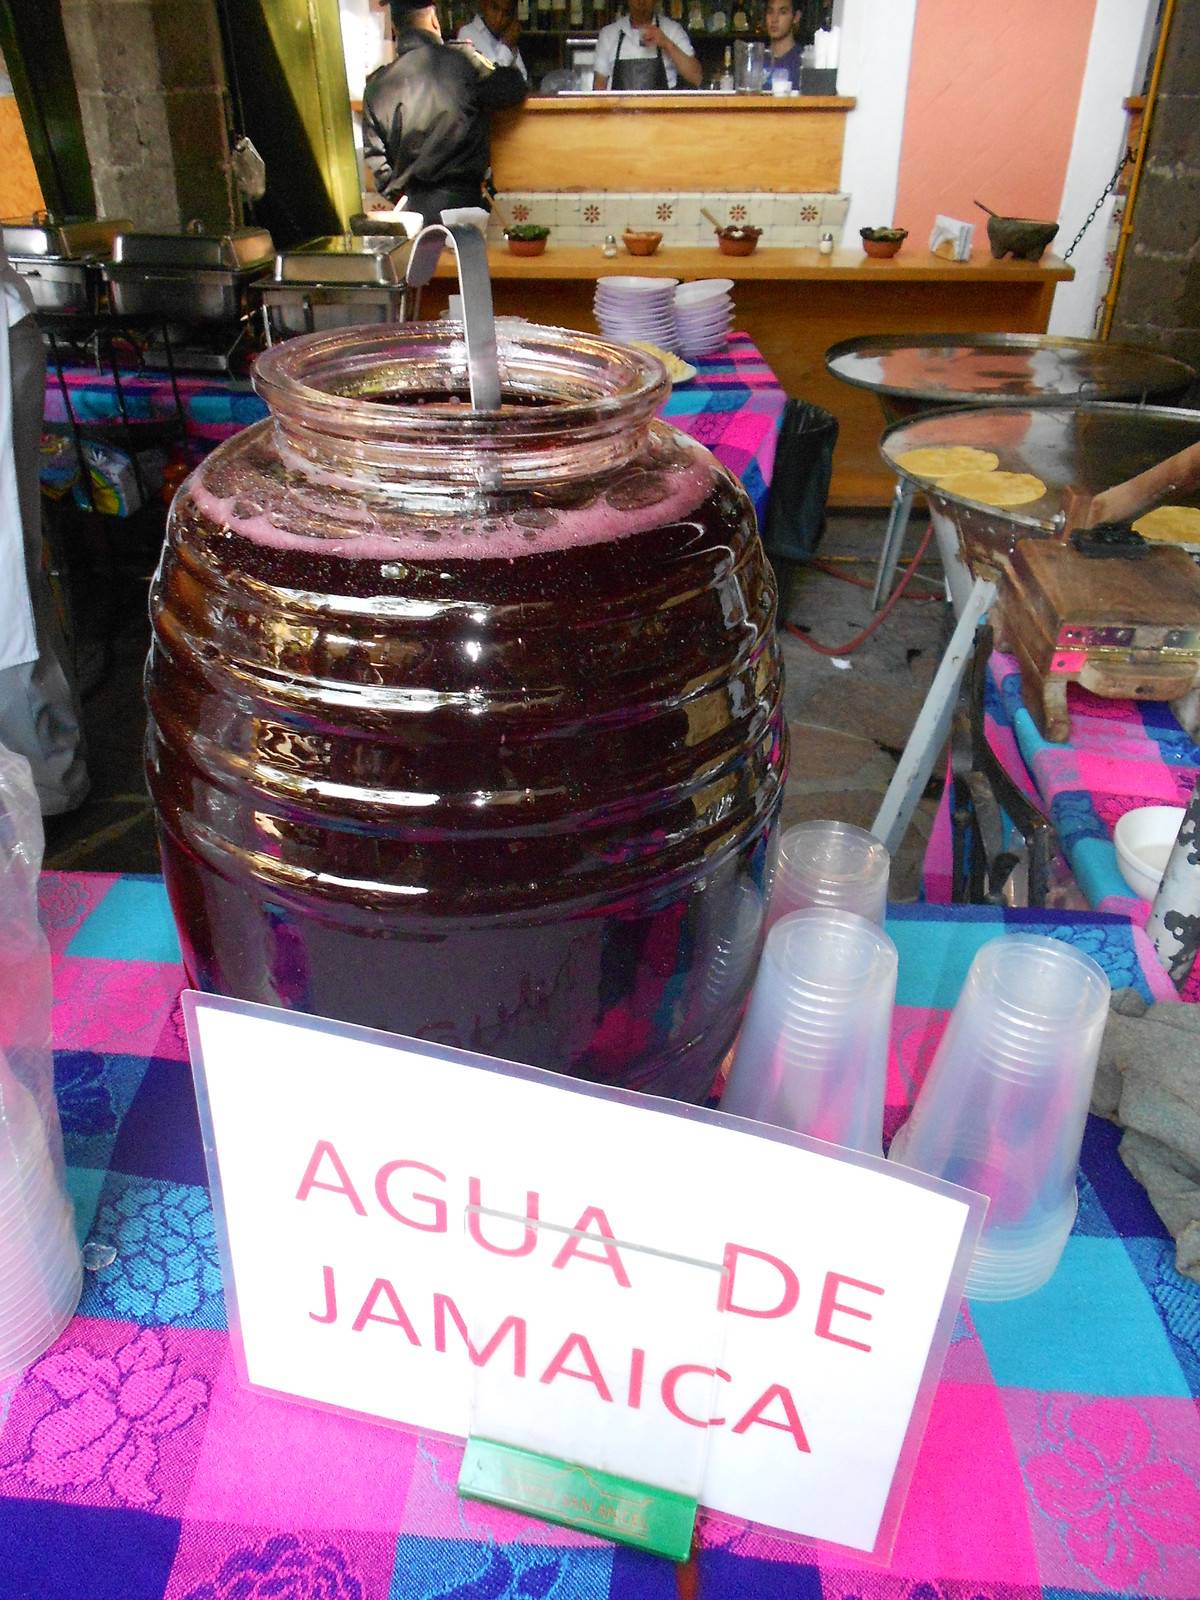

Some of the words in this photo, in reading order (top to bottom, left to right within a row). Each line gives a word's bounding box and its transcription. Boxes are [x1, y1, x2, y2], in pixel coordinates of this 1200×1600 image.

[297, 1140, 630, 1287] AGUA
[717, 1243, 885, 1352] DE
[310, 1267, 812, 1454] JAMAICA
